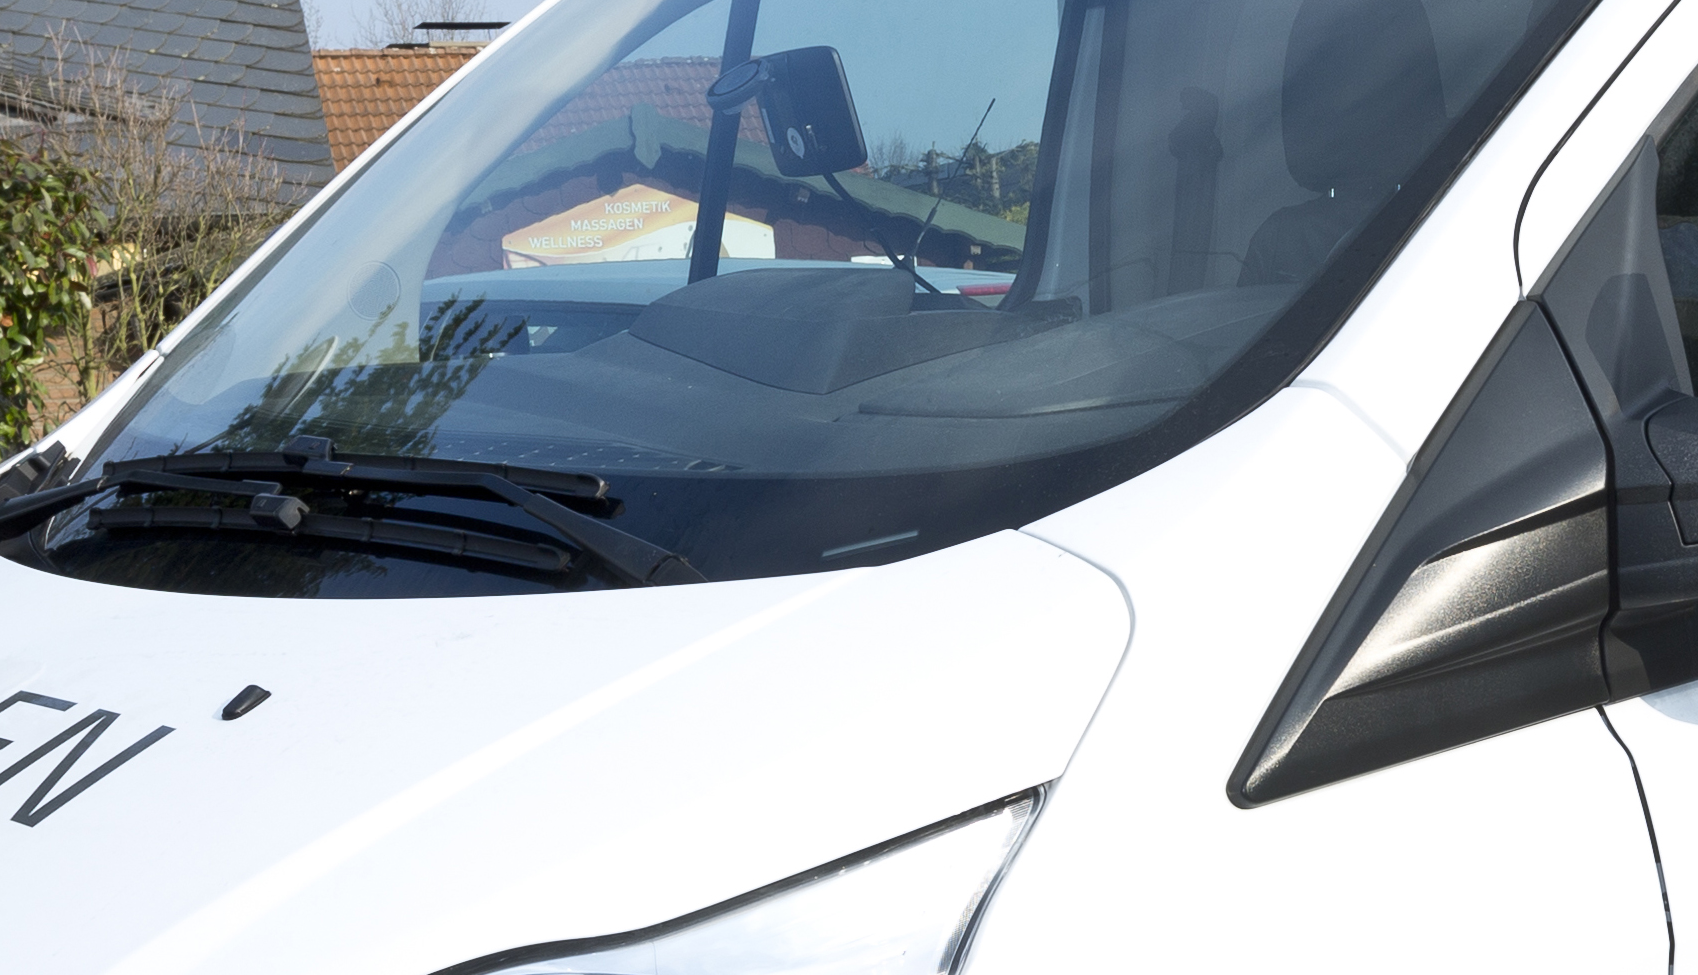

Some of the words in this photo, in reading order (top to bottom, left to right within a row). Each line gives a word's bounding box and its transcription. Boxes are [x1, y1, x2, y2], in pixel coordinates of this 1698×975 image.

[604, 200, 671, 215] KOSMETIK
[570, 217, 644, 232] MASSAGEN
[528, 235, 603, 249] WELLNESS
